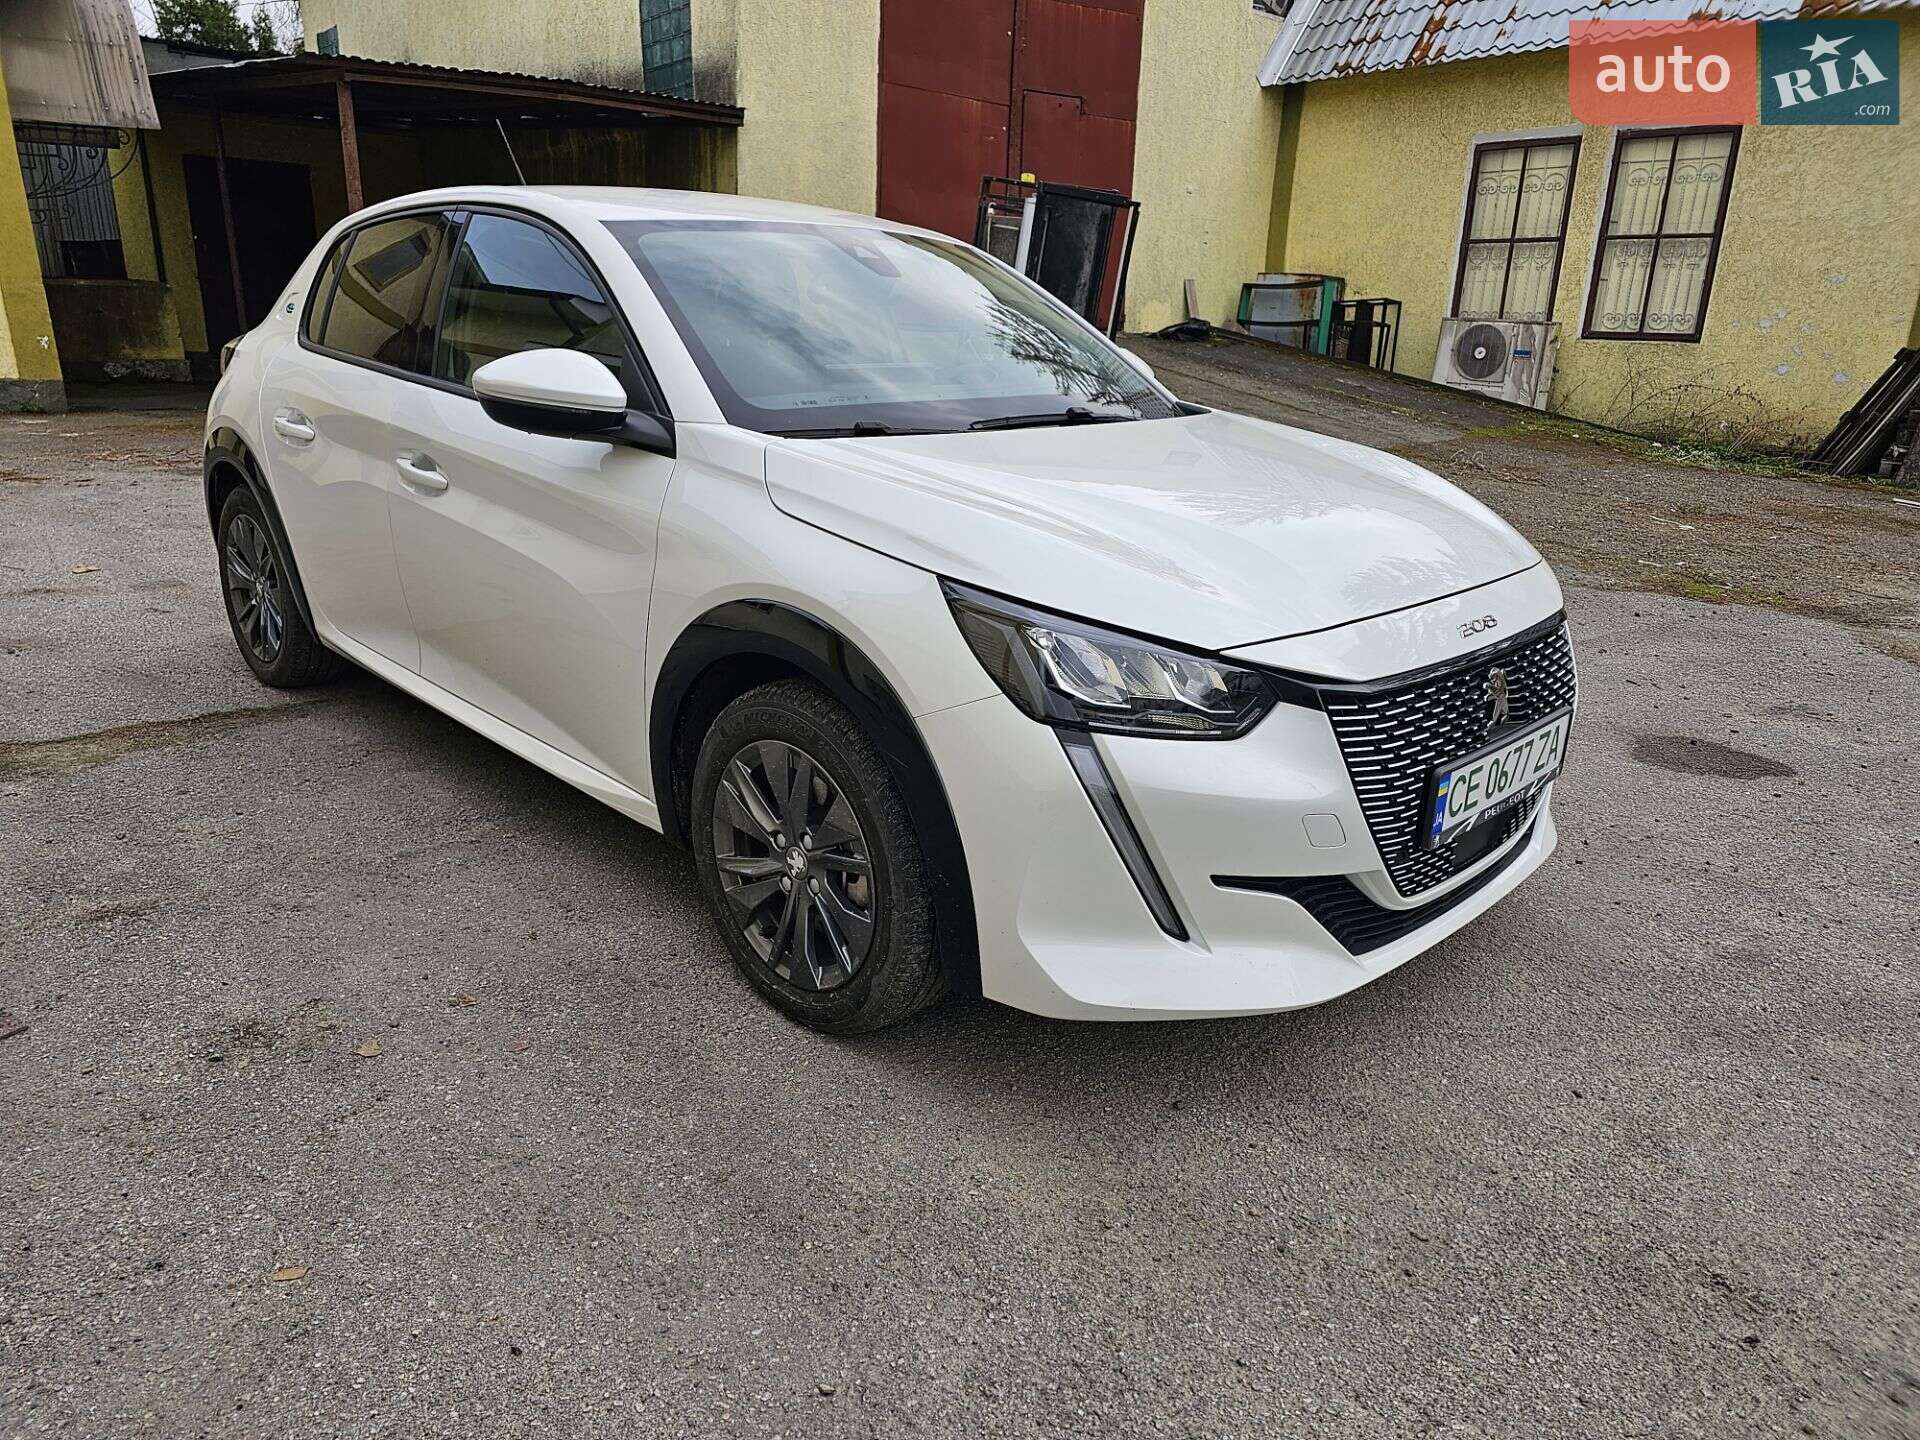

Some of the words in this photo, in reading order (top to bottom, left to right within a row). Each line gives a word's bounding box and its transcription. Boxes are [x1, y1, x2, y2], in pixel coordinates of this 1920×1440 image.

[1457, 614, 1498, 638] 208
[1450, 765, 1484, 818] CE
[1485, 738, 1535, 800] 0677
[1533, 725, 1558, 772] ZA
